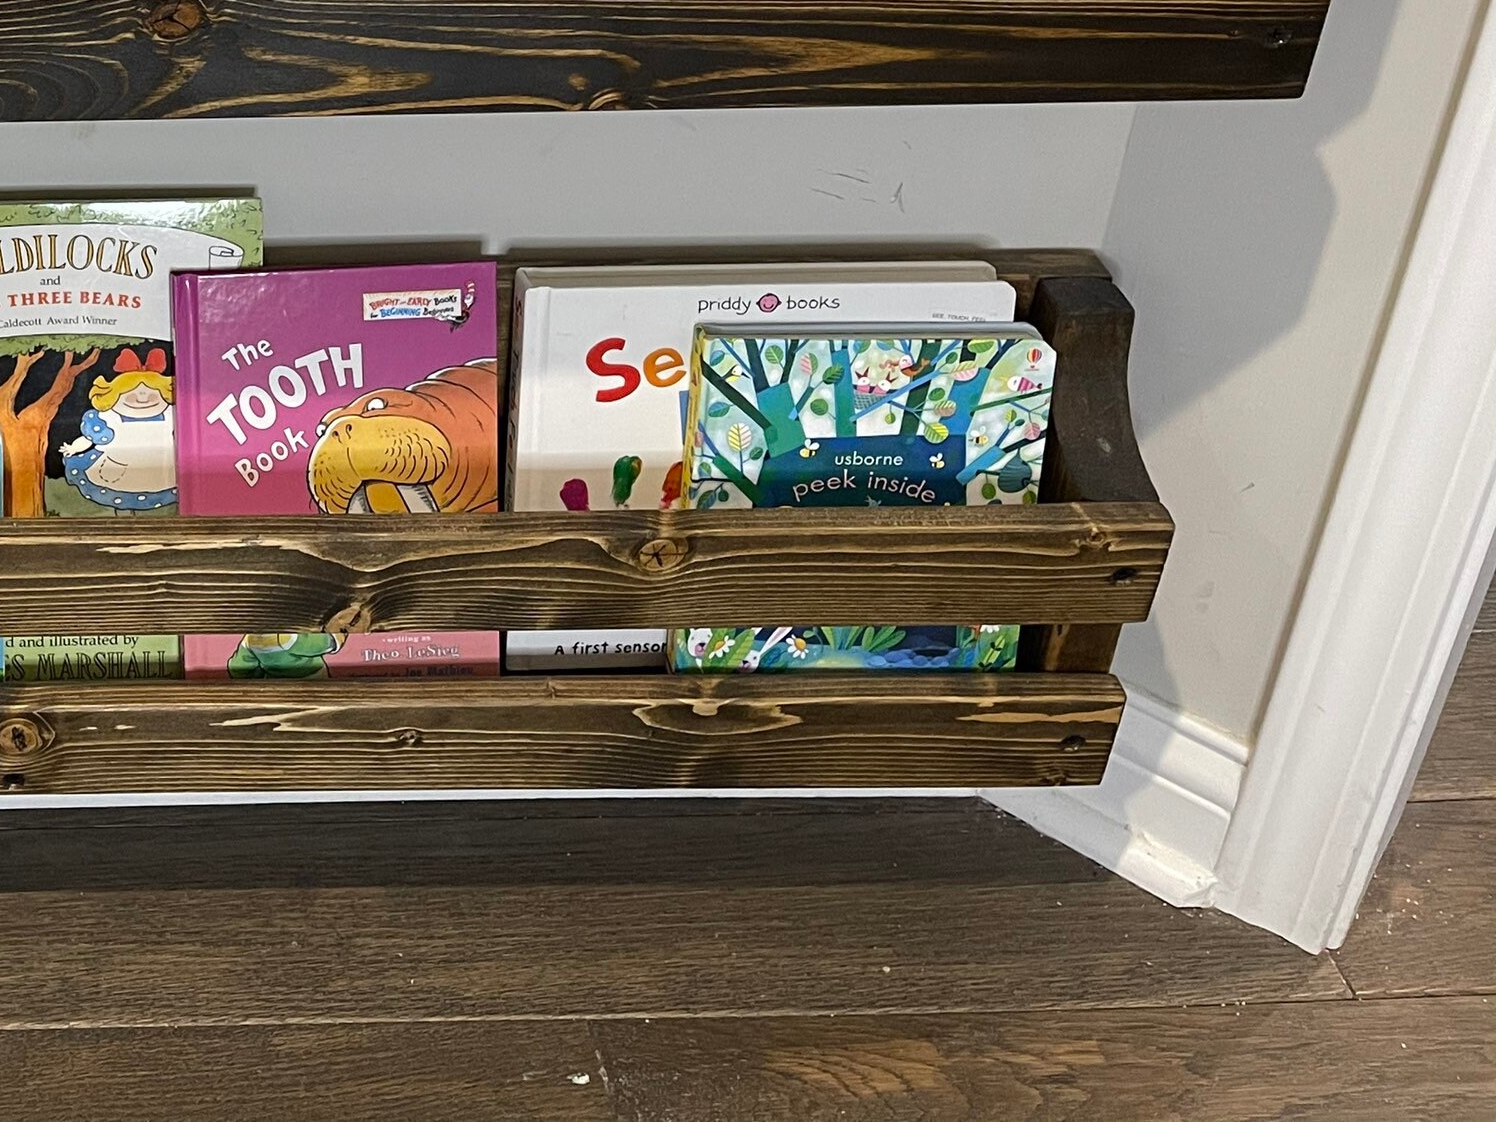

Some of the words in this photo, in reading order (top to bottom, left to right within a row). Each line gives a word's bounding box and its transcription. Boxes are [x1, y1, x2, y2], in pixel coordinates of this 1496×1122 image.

[39, 276, 61, 286] and
[7, 291, 73, 307] THREE
[79, 291, 141, 309] BEARS
[407, 297, 432, 306] EARLY
[697, 294, 752, 316] priddy
[785, 292, 842, 311] books
[46, 316, 79, 326] Award
[82, 314, 117, 326] Winner
[221, 338, 274, 372] The
[584, 337, 687, 403] Se
[206, 342, 364, 446] TOOTH
[234, 427, 309, 488] Book
[834, 451, 904, 466] usborne
[792, 472, 856, 499] peek
[867, 470, 938, 504] inside
[19, 635, 45, 648] and
[50, 635, 118, 646] illustrated
[123, 635, 139, 649] by
[554, 645, 565, 655] A
[572, 641, 609, 655] first
[614, 642, 667, 654] sensor
[36, 651, 173, 680] MARSHALL
